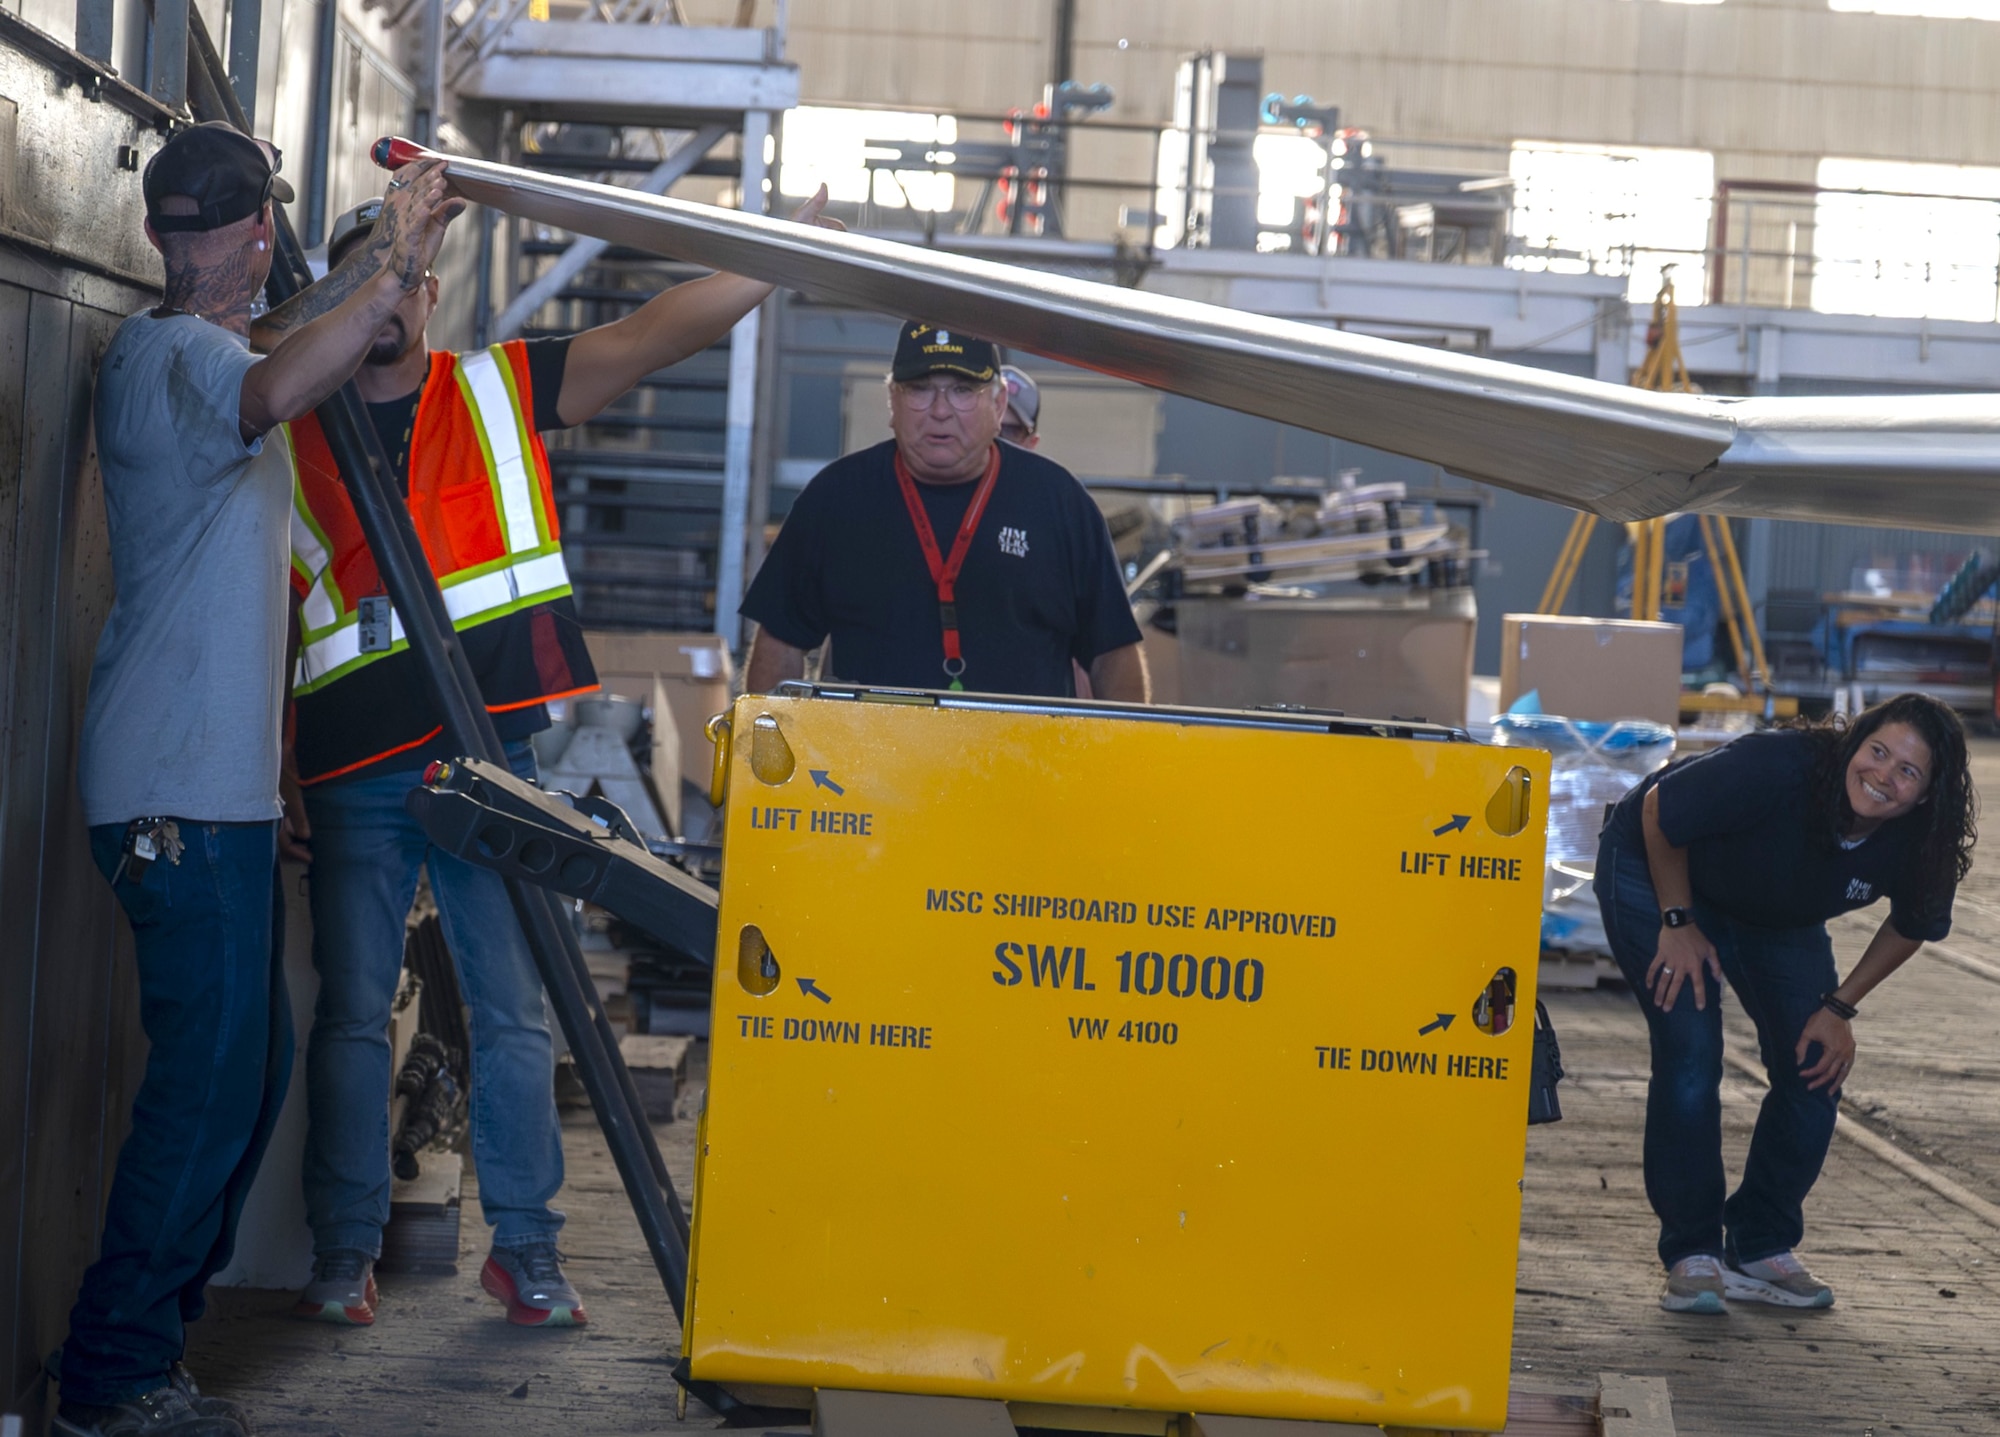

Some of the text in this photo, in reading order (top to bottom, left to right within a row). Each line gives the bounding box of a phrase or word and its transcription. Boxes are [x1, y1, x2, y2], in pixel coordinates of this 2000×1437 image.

[922, 345, 963, 355] VETERAN
[752, 807, 872, 835] LIFT HERE
[1401, 852, 1520, 880] LIFT HERE
[927, 889, 1336, 937] MSC SHIPBOARD USE APPROVED
[993, 942, 1264, 1002] SWL 10000
[737, 1016, 932, 1048] TIE DOWN HERE
[1069, 1018, 1178, 1044] VW 4100
[1316, 1047, 1509, 1079] TIE DOWN HERE
